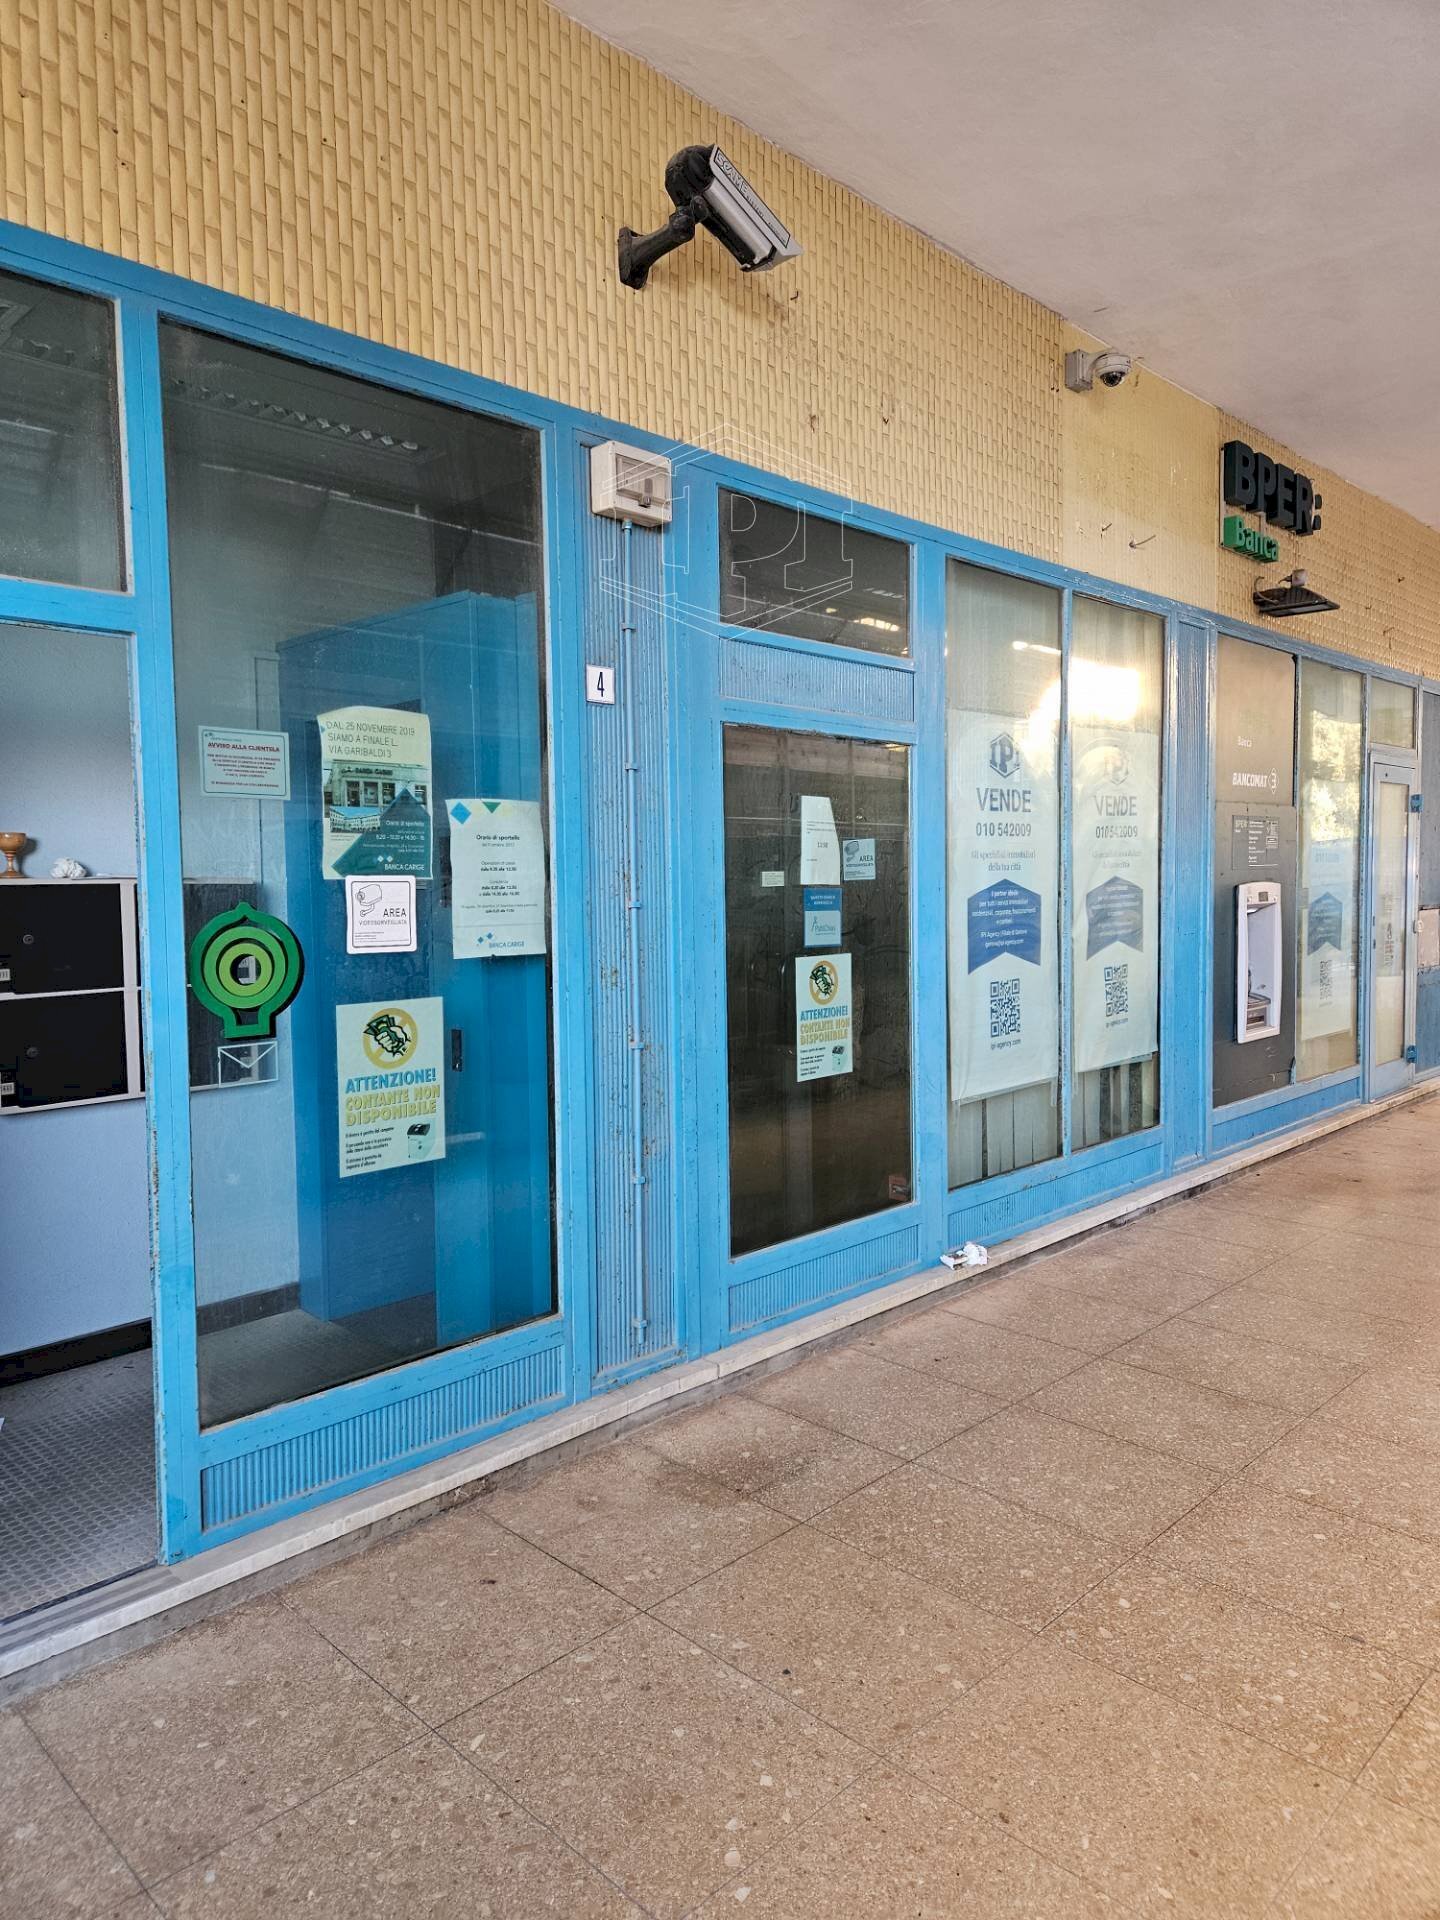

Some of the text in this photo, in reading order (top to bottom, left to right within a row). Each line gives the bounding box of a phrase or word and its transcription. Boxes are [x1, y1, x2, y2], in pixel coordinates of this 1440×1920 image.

[1224, 515, 1279, 563] Banca
[597, 671, 605, 697] 4
[325, 721, 343, 730] DAL
[346, 722, 355, 731] 25
[356, 723, 397, 734] NOVEMBRE
[327, 733, 353, 742] SIAMO
[355, 735, 361, 743] A
[363, 736, 391, 746] FINALE
[328, 745, 392, 758] VIA GARIBALDI 3
[1232, 772, 1267, 788] BANCOMAT
[976, 787, 1032, 813] VENDE
[1094, 795, 1138, 816] VENDE
[976, 822, 1032, 837] 010 542009
[383, 908, 406, 917] AREA
[800, 1006, 848, 1020] ATTENZIONE!
[345, 1068, 436, 1094] ATTENZIONE!
[345, 1084, 440, 1111] CONTANTE NON
[345, 1100, 437, 1126] DISPONIBILE
